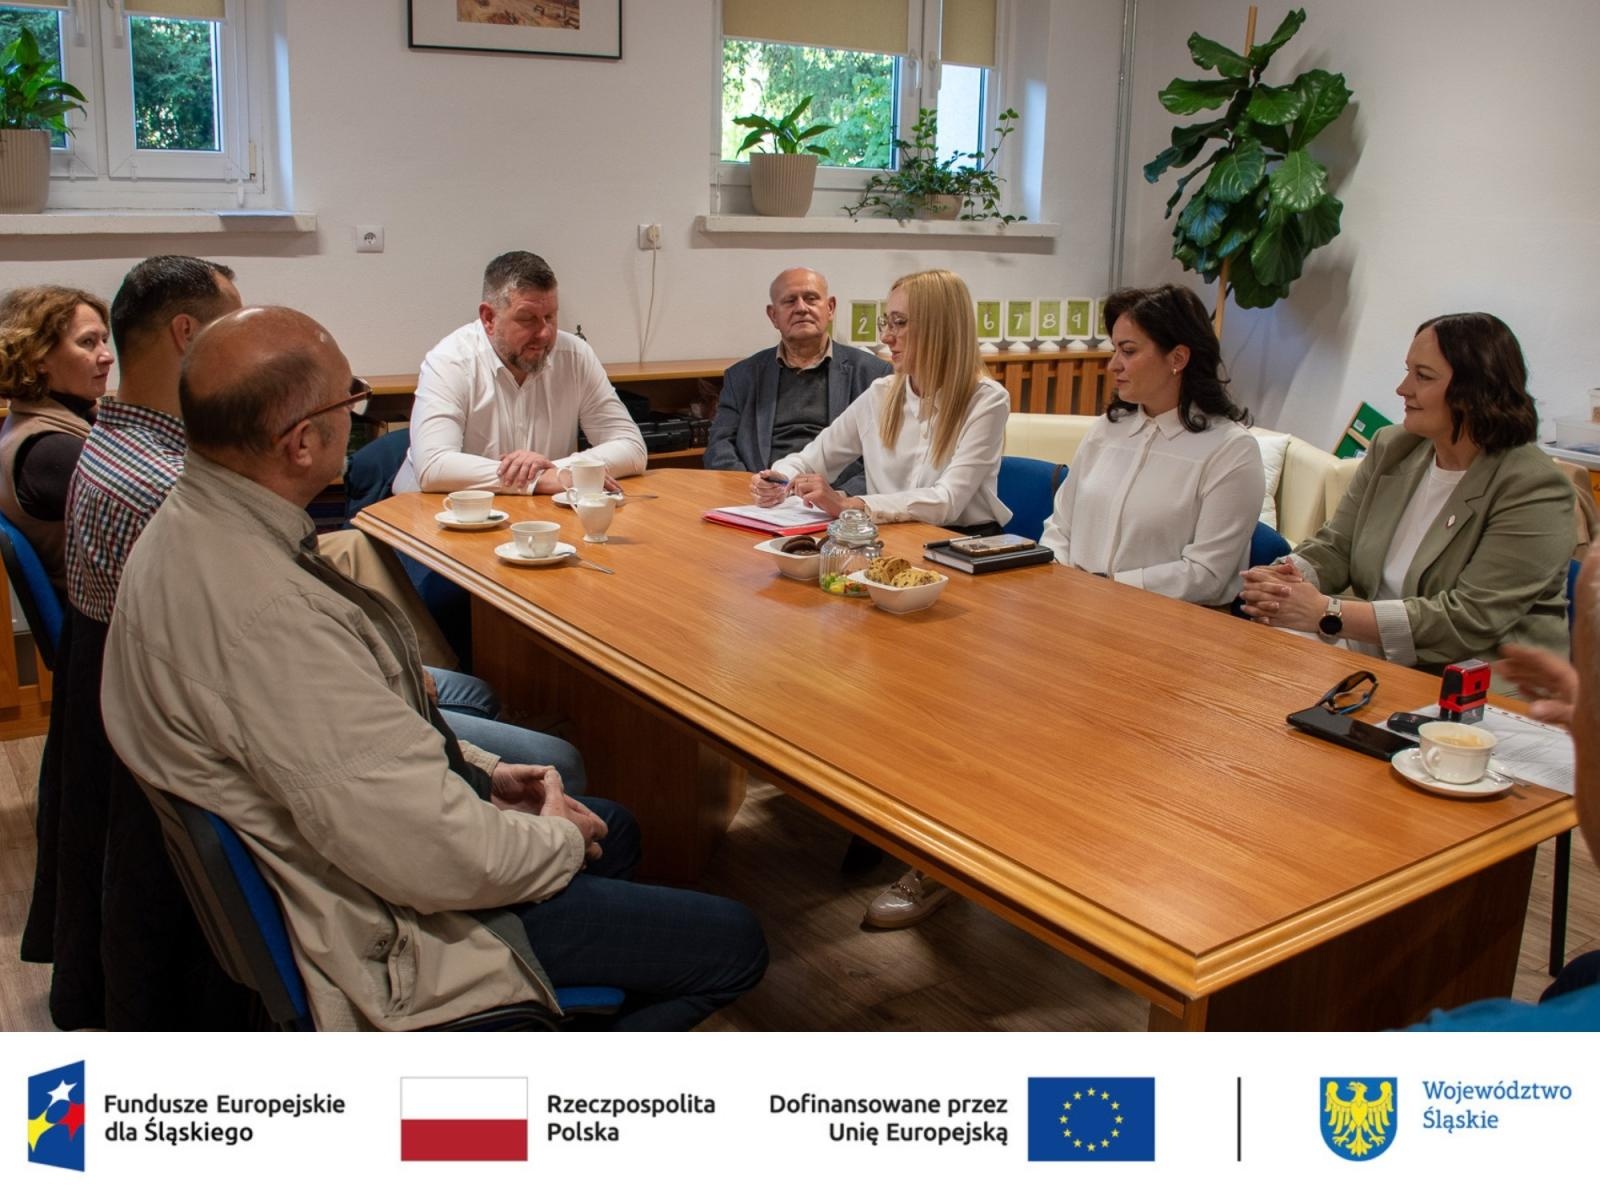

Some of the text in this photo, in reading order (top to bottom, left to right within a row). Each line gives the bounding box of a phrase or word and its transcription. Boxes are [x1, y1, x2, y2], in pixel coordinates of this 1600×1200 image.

[857, 316, 870, 335] 2
[983, 313, 995, 330] 6
[1013, 313, 1024, 330] 7
[1042, 313, 1057, 329] 8
[1071, 312, 1082, 329] 9
